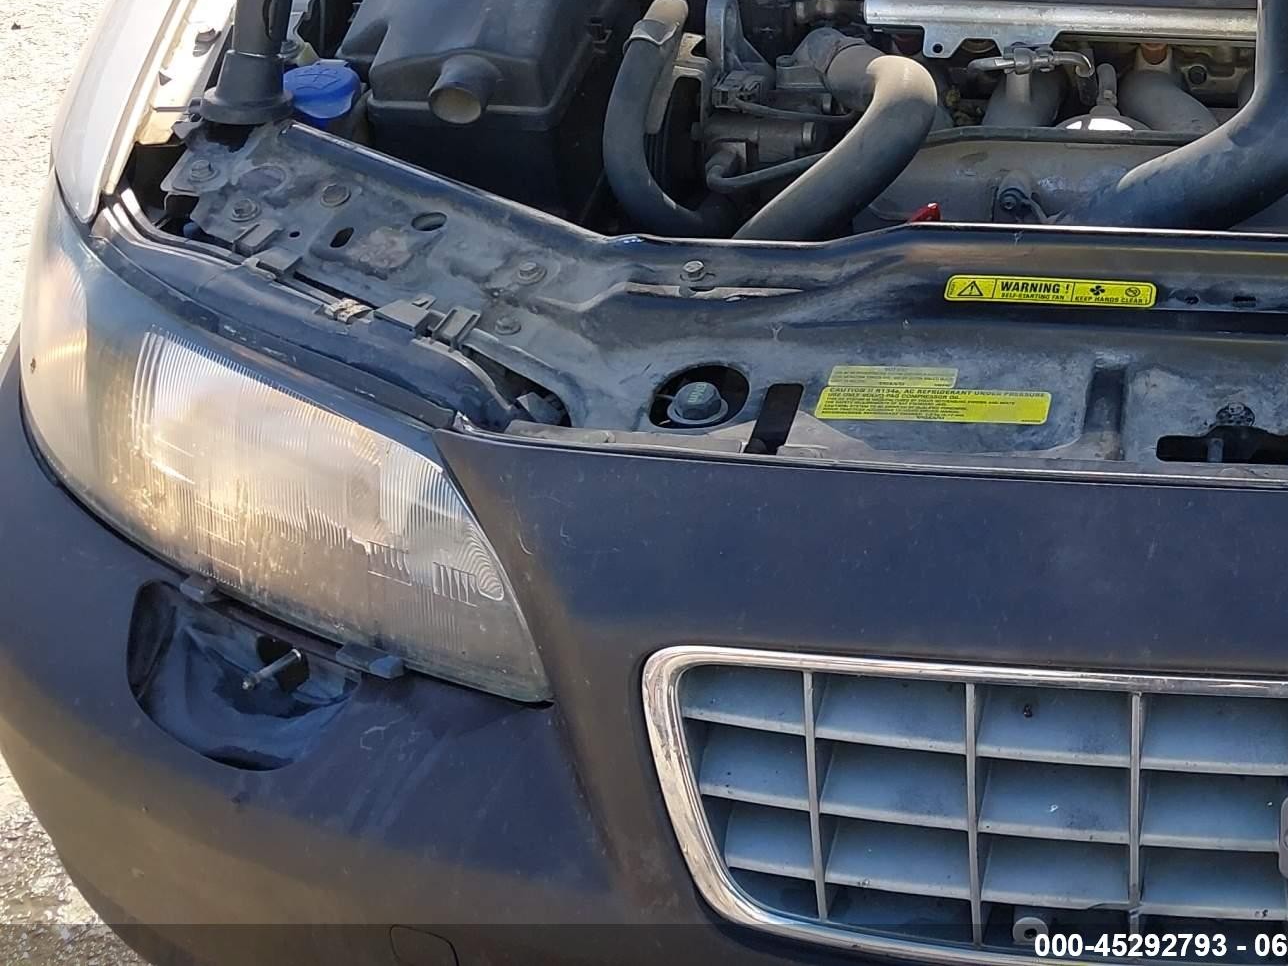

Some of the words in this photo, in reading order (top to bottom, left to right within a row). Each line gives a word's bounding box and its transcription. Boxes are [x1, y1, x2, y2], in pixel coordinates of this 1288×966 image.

[1000, 281, 1061, 294] WARNING
[1000, 292, 1050, 300] SELF-STARTING
[829, 386, 865, 394] CAUTION
